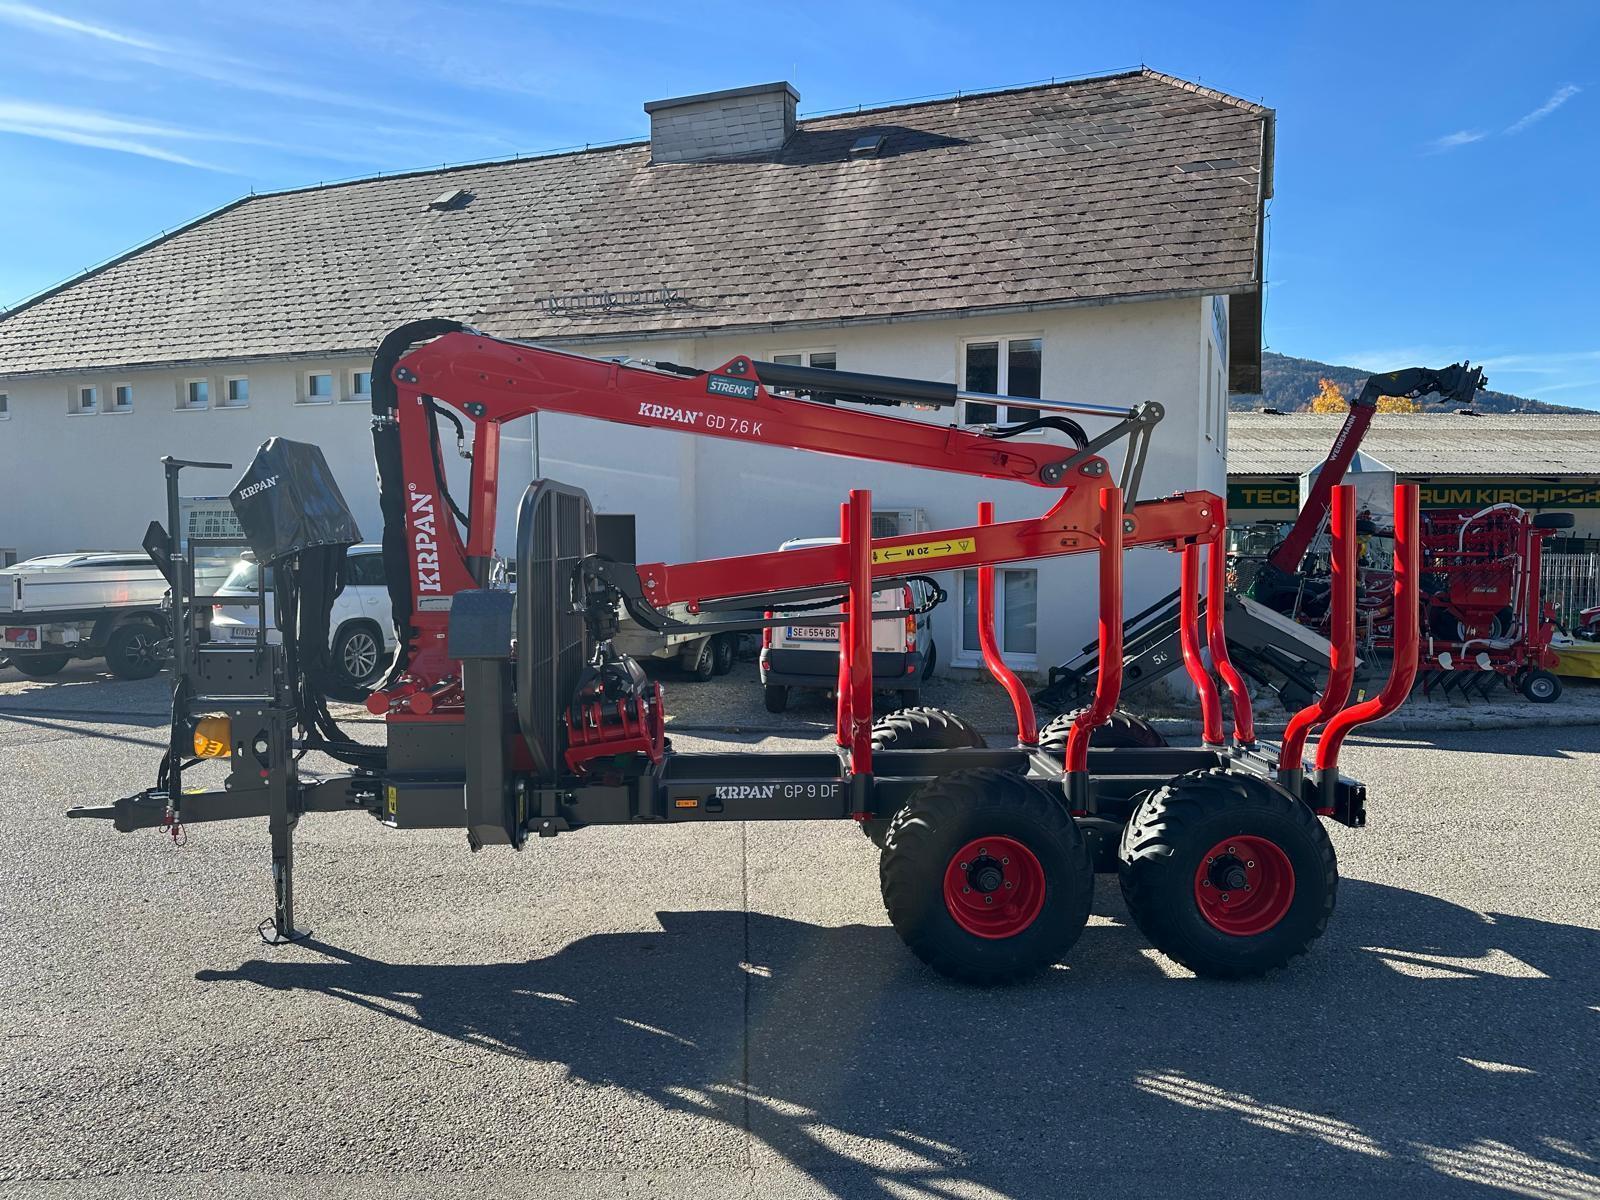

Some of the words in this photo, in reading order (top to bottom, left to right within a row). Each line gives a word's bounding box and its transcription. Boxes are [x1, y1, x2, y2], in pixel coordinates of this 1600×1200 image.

[710, 381, 748, 395] STRENX
[706, 414, 725, 429] GD
[729, 418, 748, 434] 7,6
[752, 422, 763, 435] K
[1329, 414, 1357, 461] WEIDEMANN
[917, 547, 929, 555] 20
[793, 628, 803, 636] SE
[809, 628, 824, 637] 554
[825, 629, 836, 637] BR
[784, 784, 804, 798] GP
[807, 785, 816, 798] 9
[820, 784, 839, 798] DF
